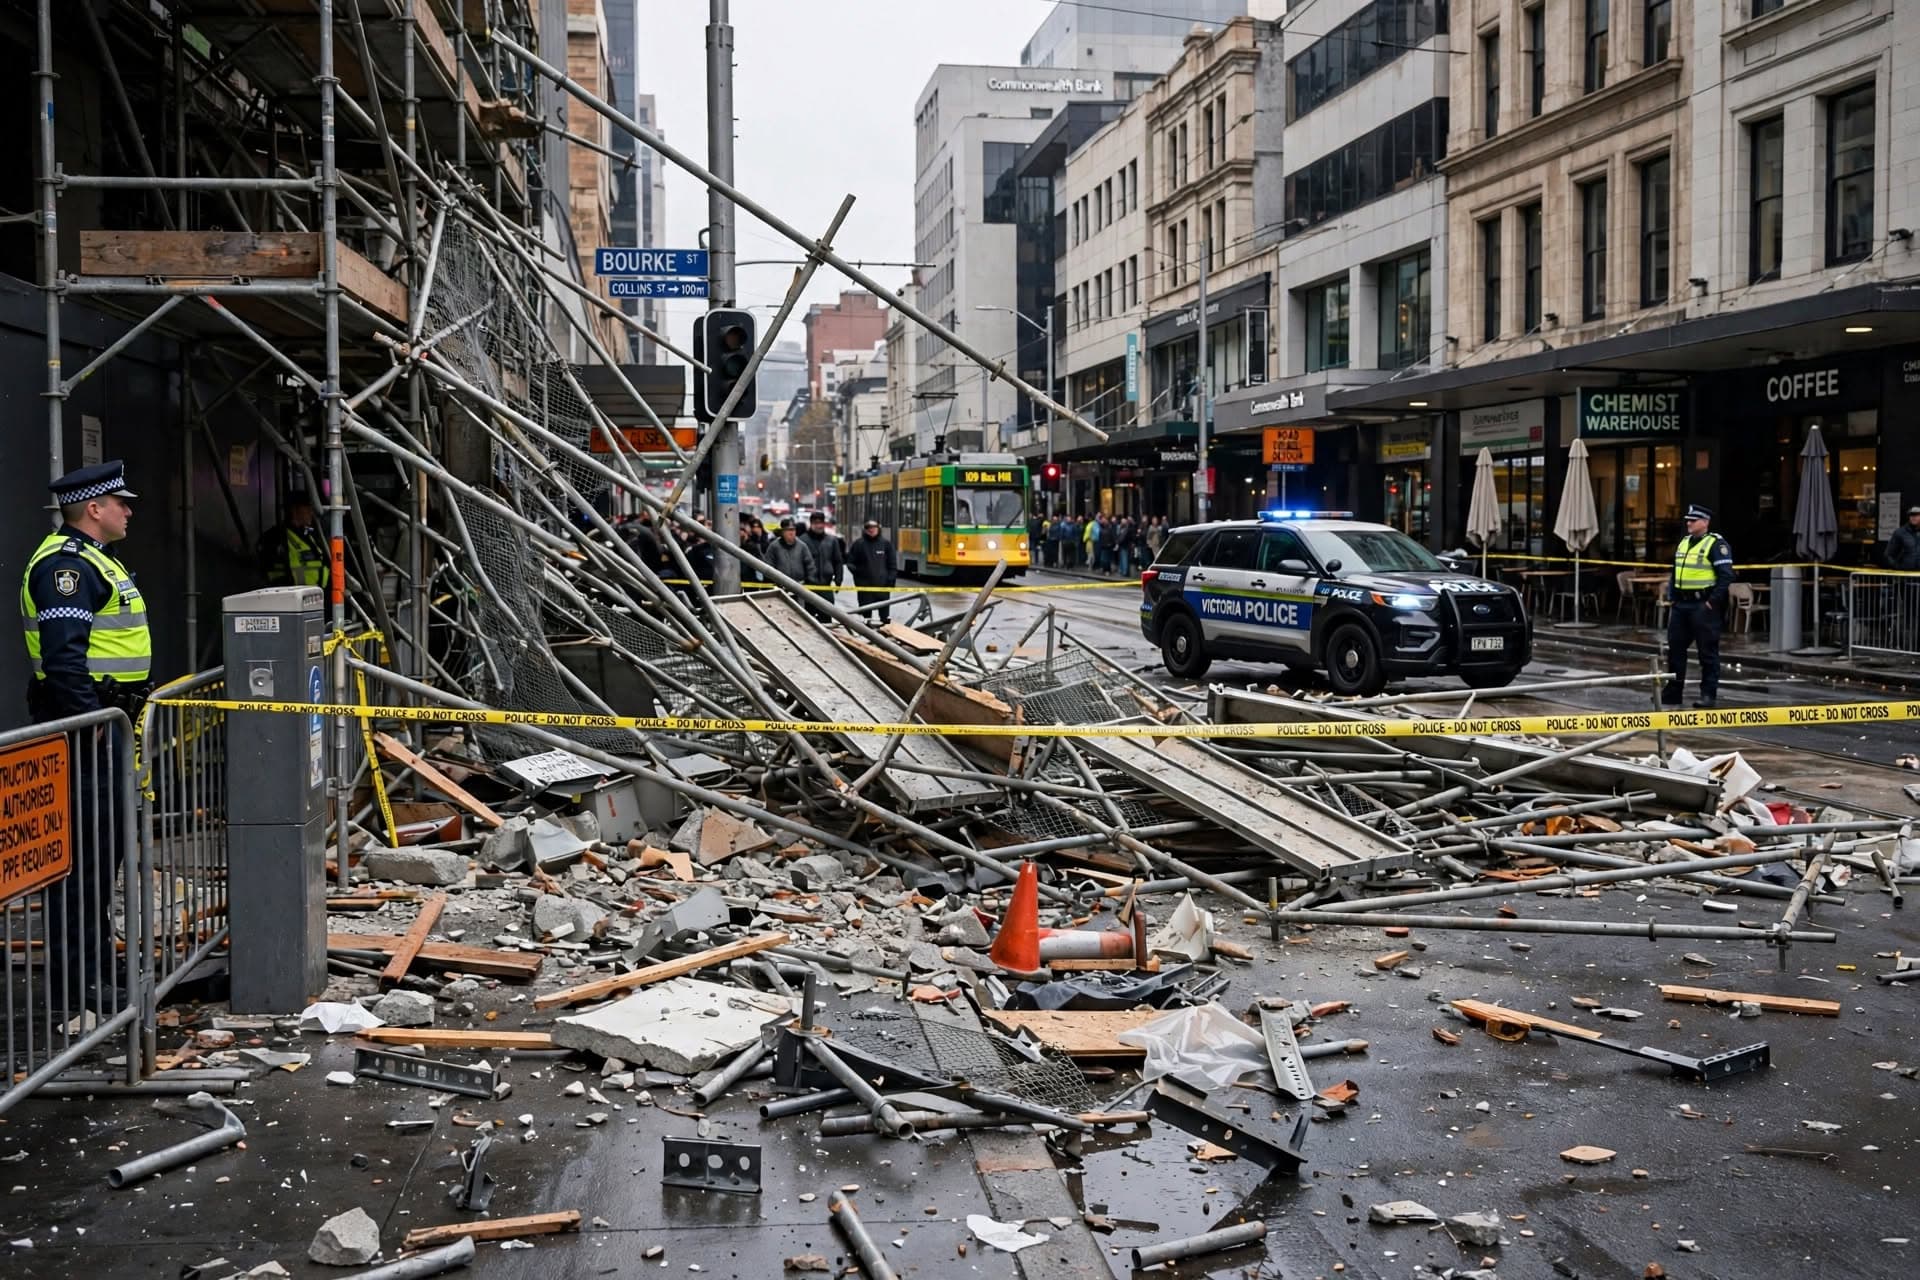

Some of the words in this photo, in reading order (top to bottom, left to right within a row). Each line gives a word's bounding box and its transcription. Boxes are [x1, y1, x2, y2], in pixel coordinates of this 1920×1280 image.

[602, 251, 678, 272] BOURKE
[686, 253, 698, 264] ST
[612, 283, 652, 295] COLLINS
[656, 284, 666, 293] ST
[681, 284, 705, 295] 100m
[1767, 369, 1839, 402] COFFEE
[1590, 393, 1680, 413] CHEMIST
[1586, 415, 1681, 431] WAREHOUSE
[1332, 588, 1363, 600] POLICE
[1202, 598, 1241, 617] VICTORIA
[1245, 601, 1298, 625] POLICE
[238, 703, 273, 712] POLICE
[283, 704, 297, 713] DO
[301, 705, 319, 714] NOT
[323, 706, 356, 716] CROSS
[374, 708, 408, 718] POLICE
[416, 710, 431, 720] DO
[433, 710, 453, 721] NOT
[456, 711, 487, 722] CROSS
[1789, 709, 1819, 721] POLICE
[1826, 708, 1838, 720] DO
[1841, 707, 1858, 719] NOT
[1861, 706, 1889, 719] CROSS
[504, 714, 538, 724] POLICE
[547, 715, 561, 725] DO
[563, 715, 582, 726] NOT
[585, 716, 617, 726] CROSS
[634, 718, 668, 728] POLICE
[677, 719, 690, 728] DO
[693, 719, 712, 729] NOT
[1546, 719, 1578, 730] POLICE
[1586, 718, 1598, 729] DO
[1601, 717, 1618, 728] NOT
[1621, 716, 1650, 728] CROSS
[1668, 714, 1698, 726] POLICE
[1706, 713, 1718, 725] DO
[1720, 713, 1737, 724] NOT
[1740, 711, 1768, 723] CROSS
[1223, 725, 1255, 736] CROSS
[1277, 725, 1309, 736] POLICE
[1318, 725, 1332, 735] DO
[1334, 724, 1353, 735] NOT
[1355, 723, 1386, 735] CROSS
[1412, 723, 1445, 734] POLICE
[1454, 722, 1467, 733] DO
[1470, 721, 1488, 732] NOT
[1491, 720, 1521, 732] CROSS
[3, 782, 55, 820] AUTHORISED
[43, 810, 63, 835] ONLY
[3, 855, 20, 884] PPE
[22, 839, 63, 873] REQUIRED
